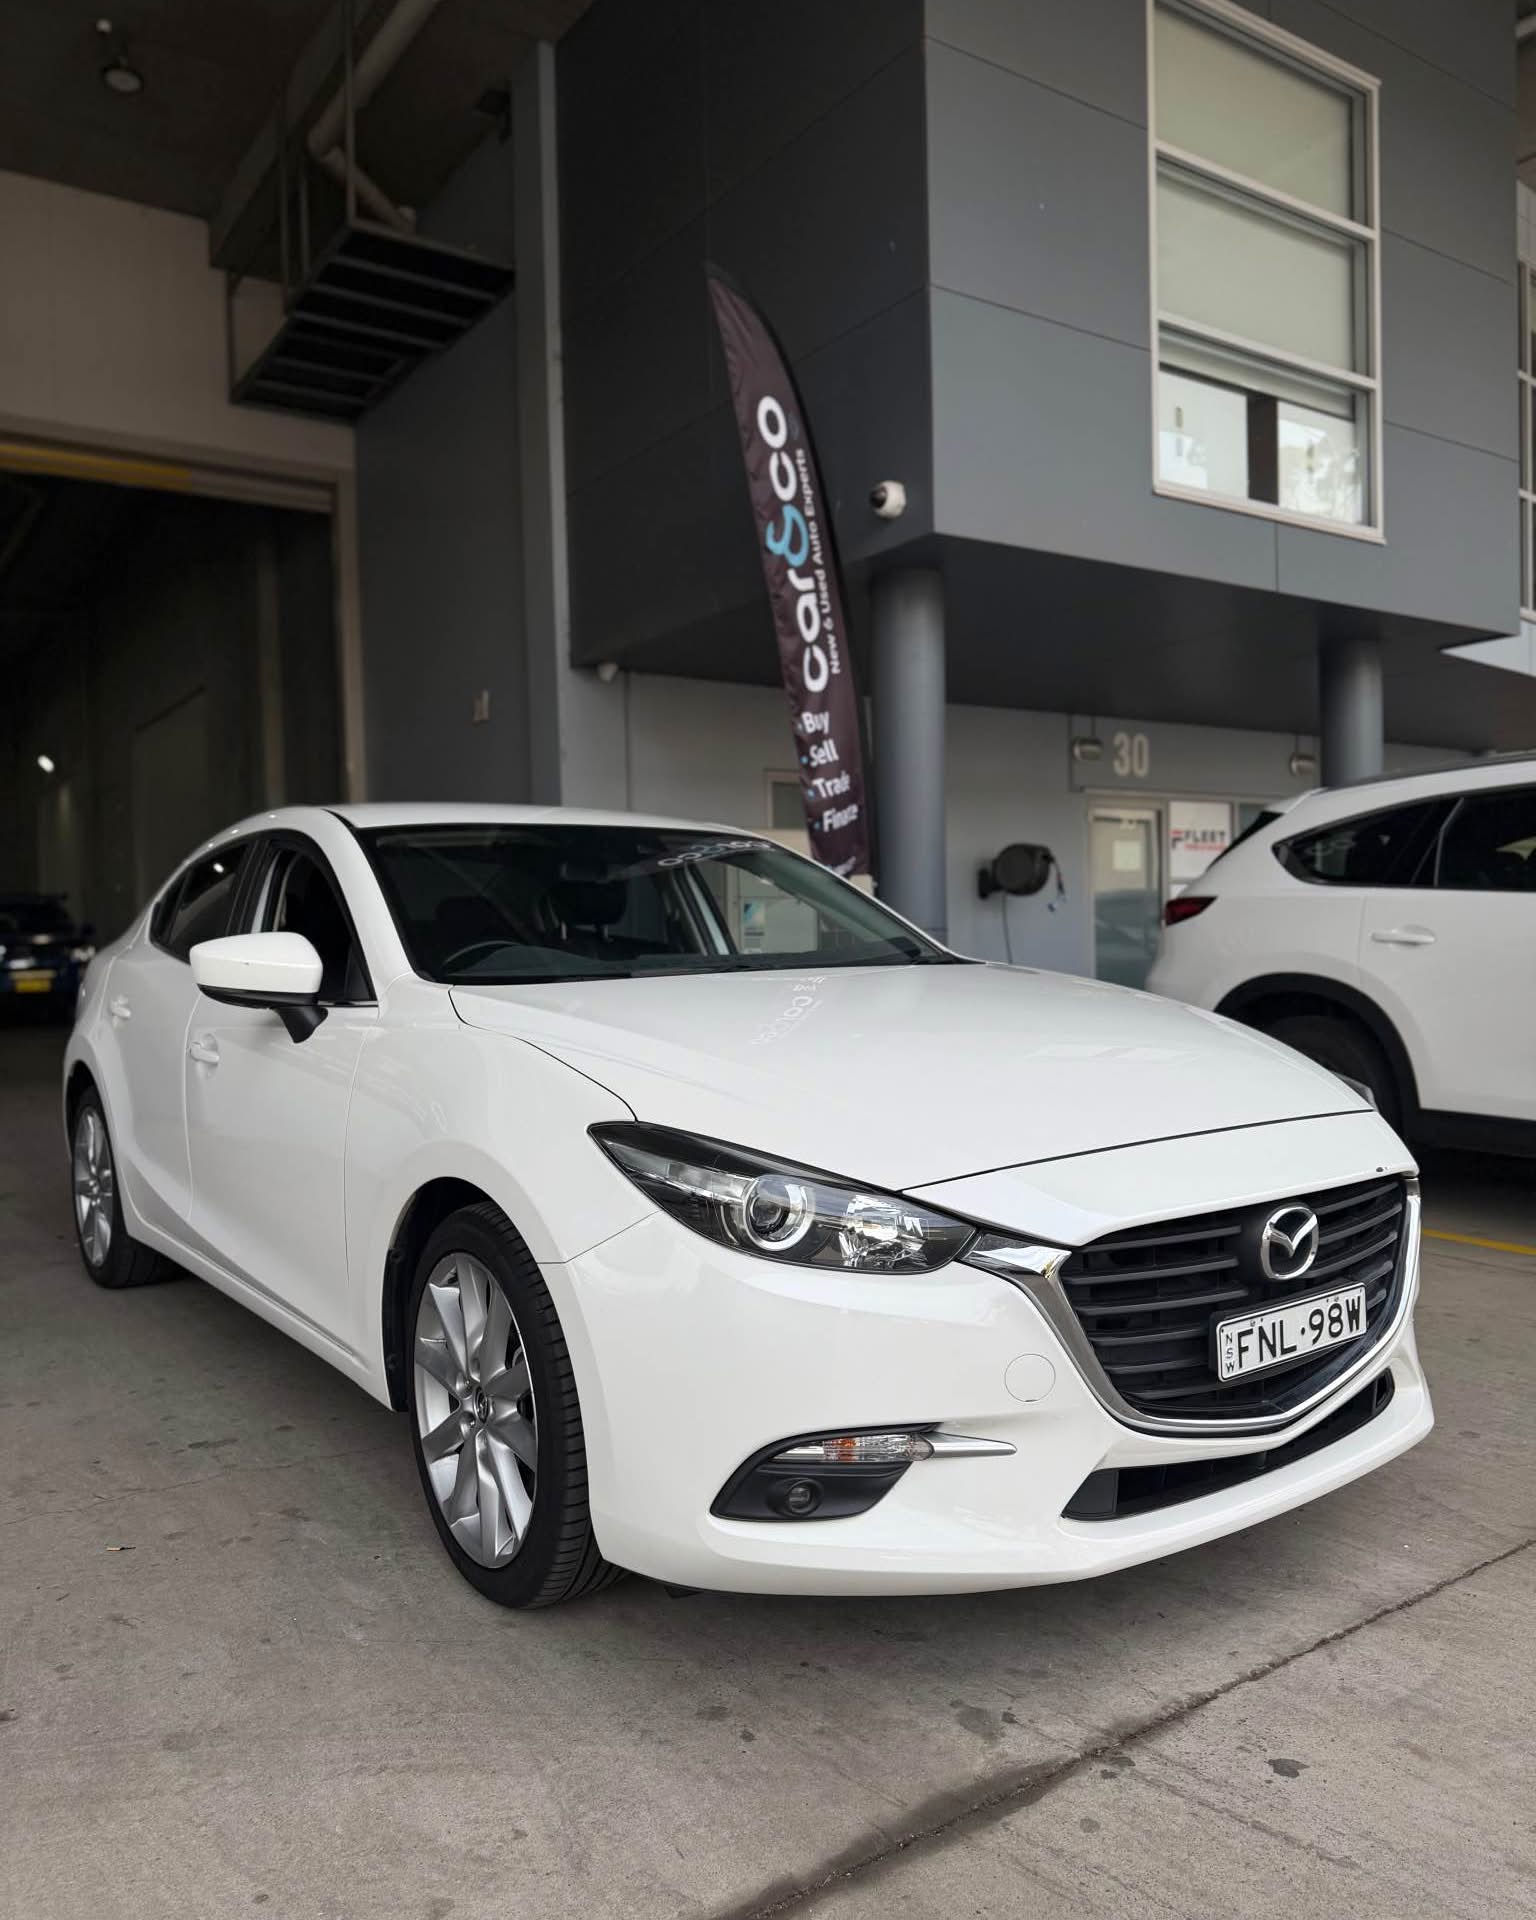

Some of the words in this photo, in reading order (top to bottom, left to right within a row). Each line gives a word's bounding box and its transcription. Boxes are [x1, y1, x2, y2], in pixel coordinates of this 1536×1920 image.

[796, 448, 816, 518] Experts
[808, 520, 824, 565] Auto
[814, 569, 832, 615] Used
[827, 634, 841, 675] New
[801, 711, 830, 735] Buy
[809, 738, 840, 768] Sell
[1113, 731, 1149, 778] 30
[1184, 829, 1226, 843] FLEET
